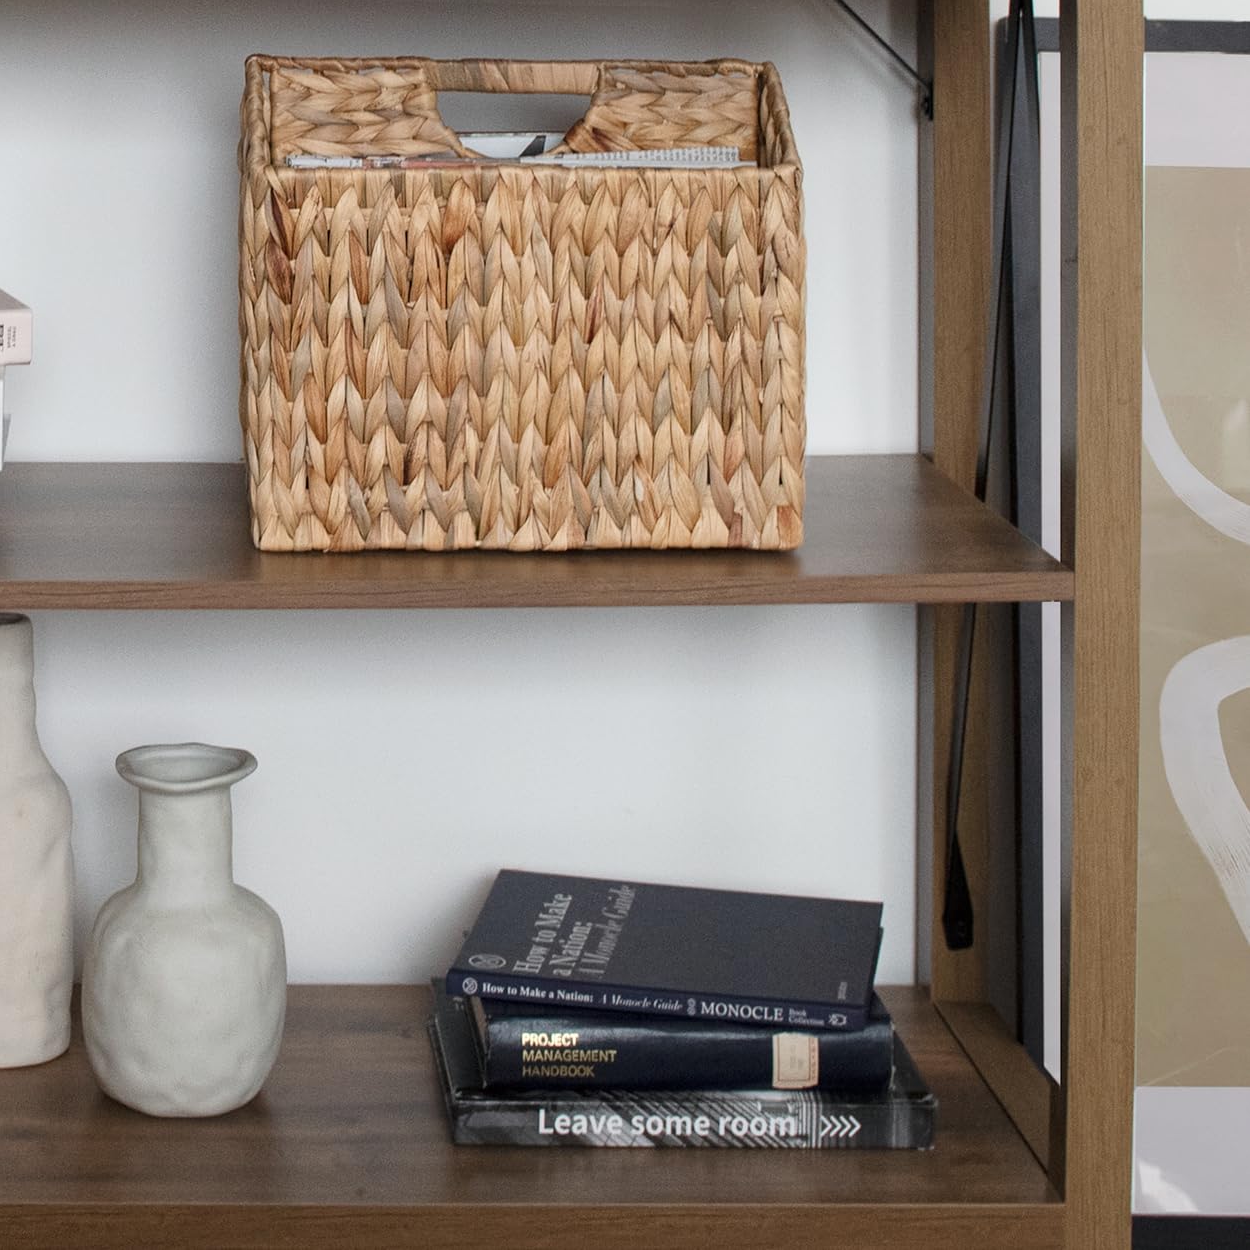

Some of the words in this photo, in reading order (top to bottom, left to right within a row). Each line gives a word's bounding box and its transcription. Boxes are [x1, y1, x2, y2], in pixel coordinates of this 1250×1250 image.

[534, 893, 572, 928] Make
[601, 885, 636, 919] Guide
[532, 930, 557, 943] to
[549, 921, 593, 967] Nation:
[581, 920, 624, 965] Monocle
[512, 944, 550, 974] How
[553, 969, 572, 977] a
[482, 982, 505, 994] How
[507, 985, 517, 996] to
[519, 986, 546, 999] Make
[548, 991, 554, 999] a
[557, 989, 594, 1003] Nation:
[611, 994, 652, 1008] Monocle
[653, 999, 683, 1011] Guide
[701, 1001, 784, 1021] MONOCLE
[521, 1032, 580, 1047] PROJECT
[522, 1049, 618, 1063] MANAGEMENT
[522, 1064, 596, 1078] HANDBOOK
[538, 1108, 624, 1137] Leave
[631, 1114, 712, 1137] some
[719, 1115, 799, 1138] room
